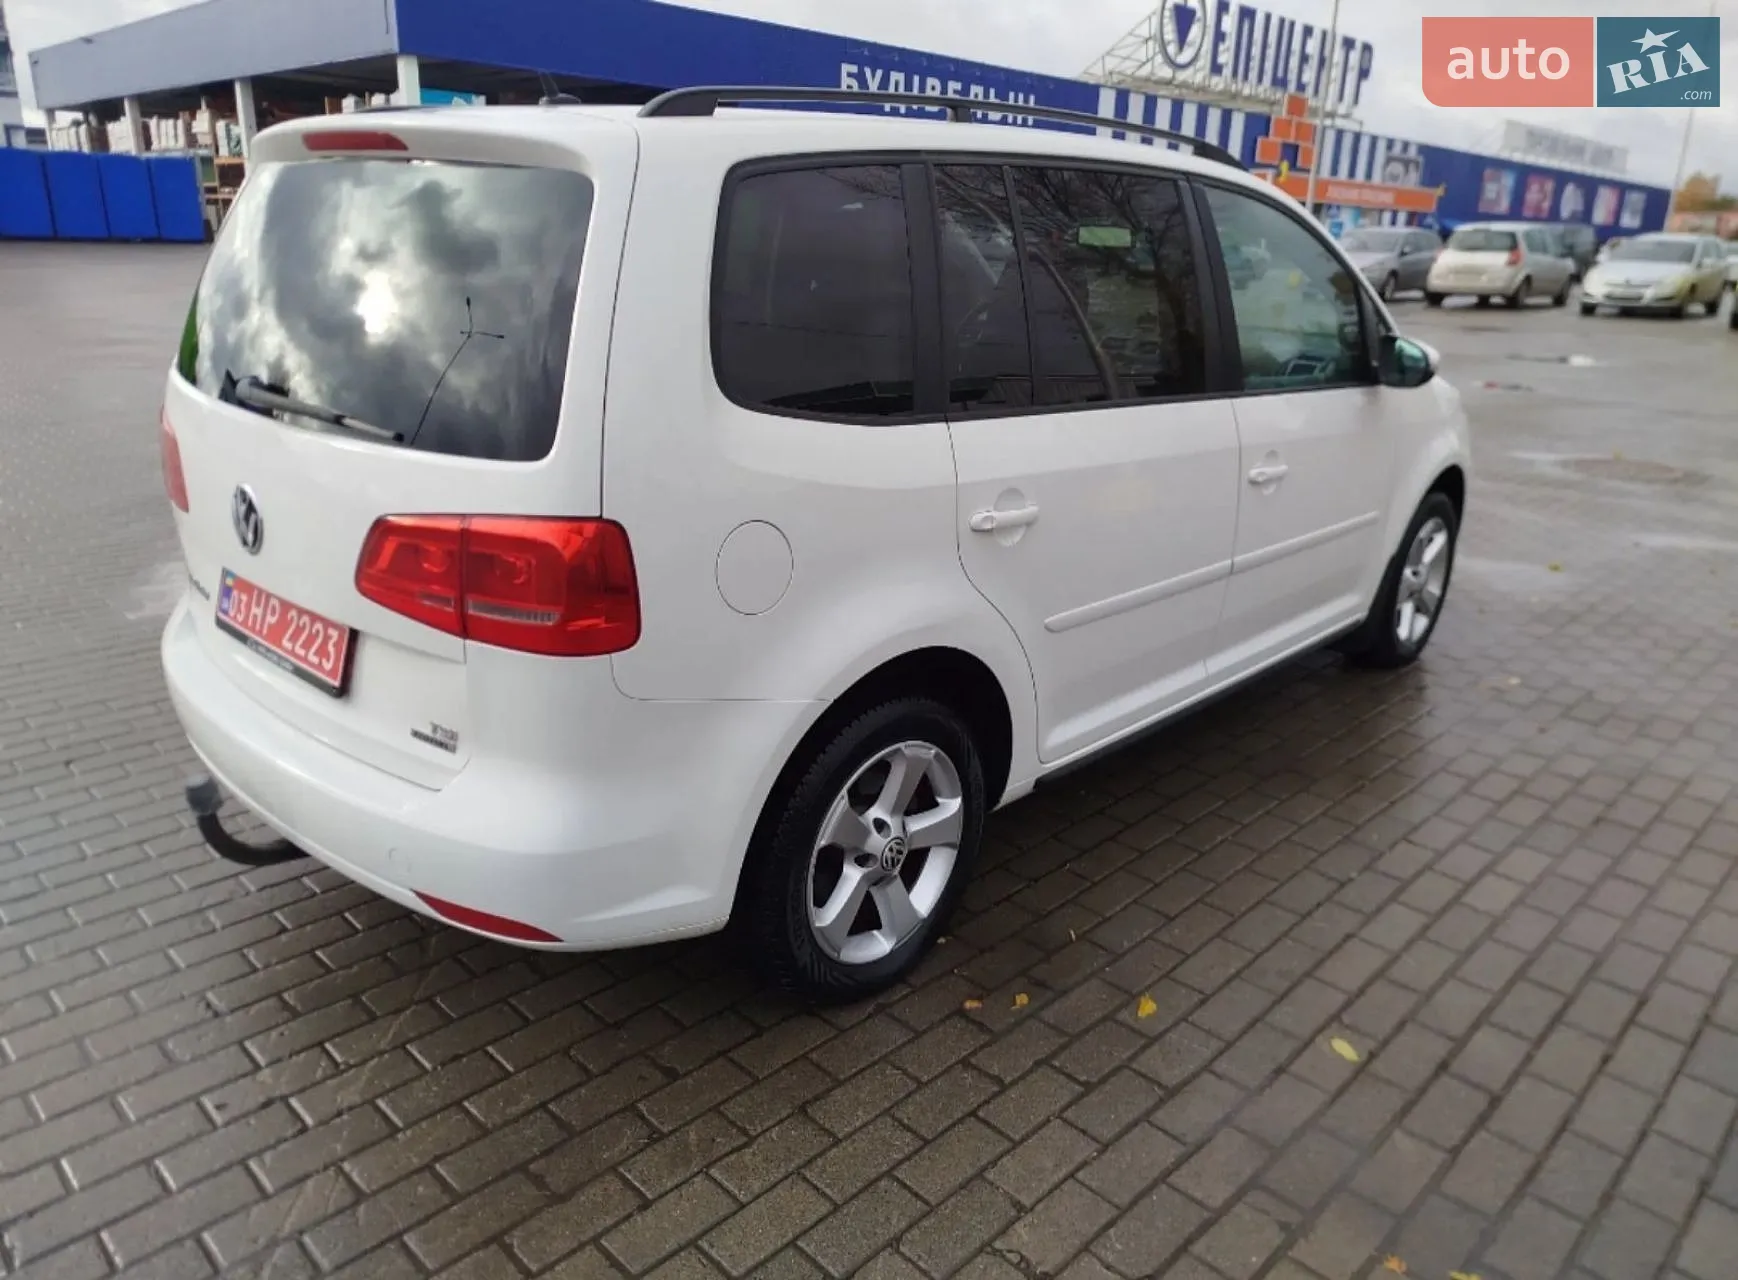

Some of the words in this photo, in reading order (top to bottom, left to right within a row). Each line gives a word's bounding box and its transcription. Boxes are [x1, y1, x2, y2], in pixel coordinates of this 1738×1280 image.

[1209, 0, 1374, 106] ЕПІЦЕНТР
[247, 587, 281, 636] HP
[281, 608, 339, 671] 2223
